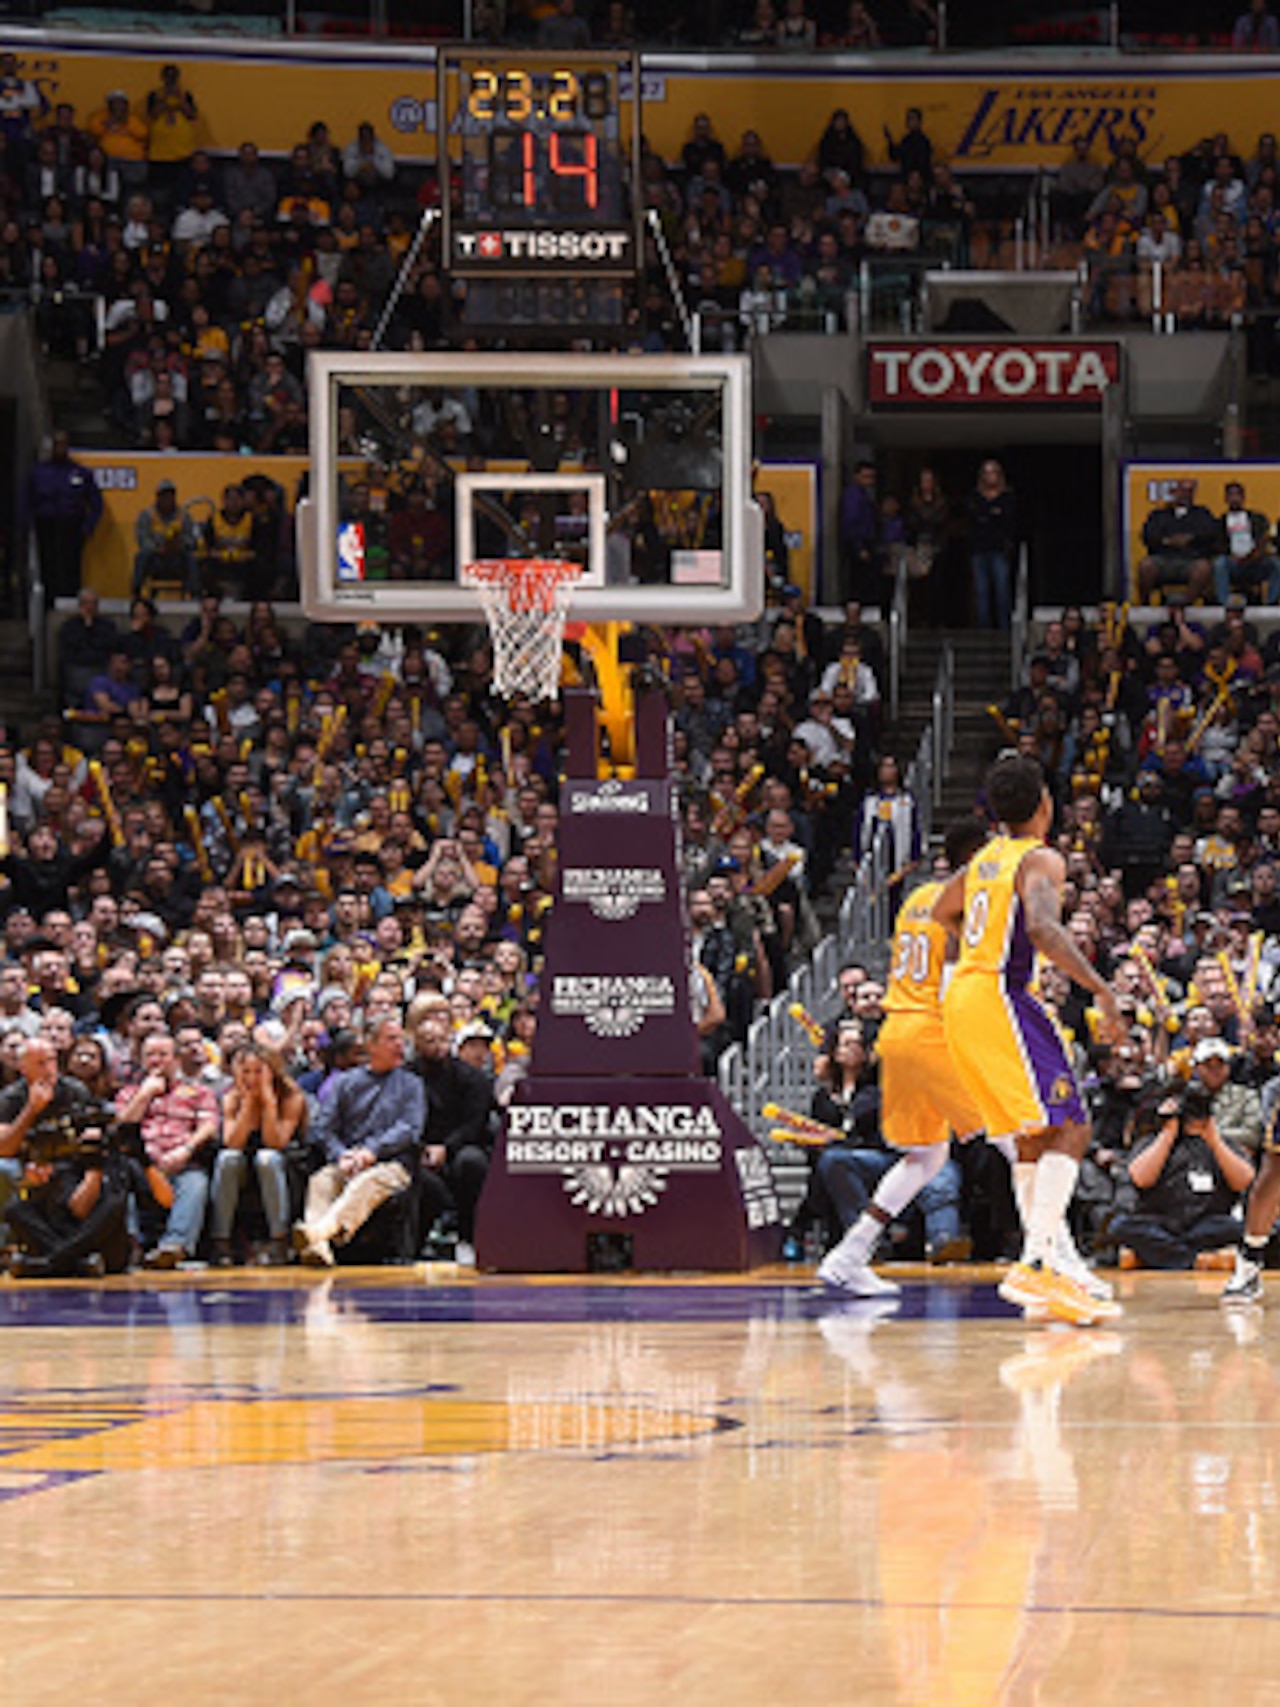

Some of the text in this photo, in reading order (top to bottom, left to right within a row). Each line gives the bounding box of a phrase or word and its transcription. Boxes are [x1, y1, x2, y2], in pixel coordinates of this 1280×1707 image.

[955, 89, 1156, 157] LAKERS
[522, 131, 598, 208] 14
[503, 232, 630, 258] TISSOT
[872, 350, 1109, 395] TOYOTA
[965, 890, 989, 948] 0
[552, 976, 675, 997] PECHANGA
[506, 1105, 722, 1137] PECHANGA
[506, 1140, 722, 1163] RESORT CASINO
